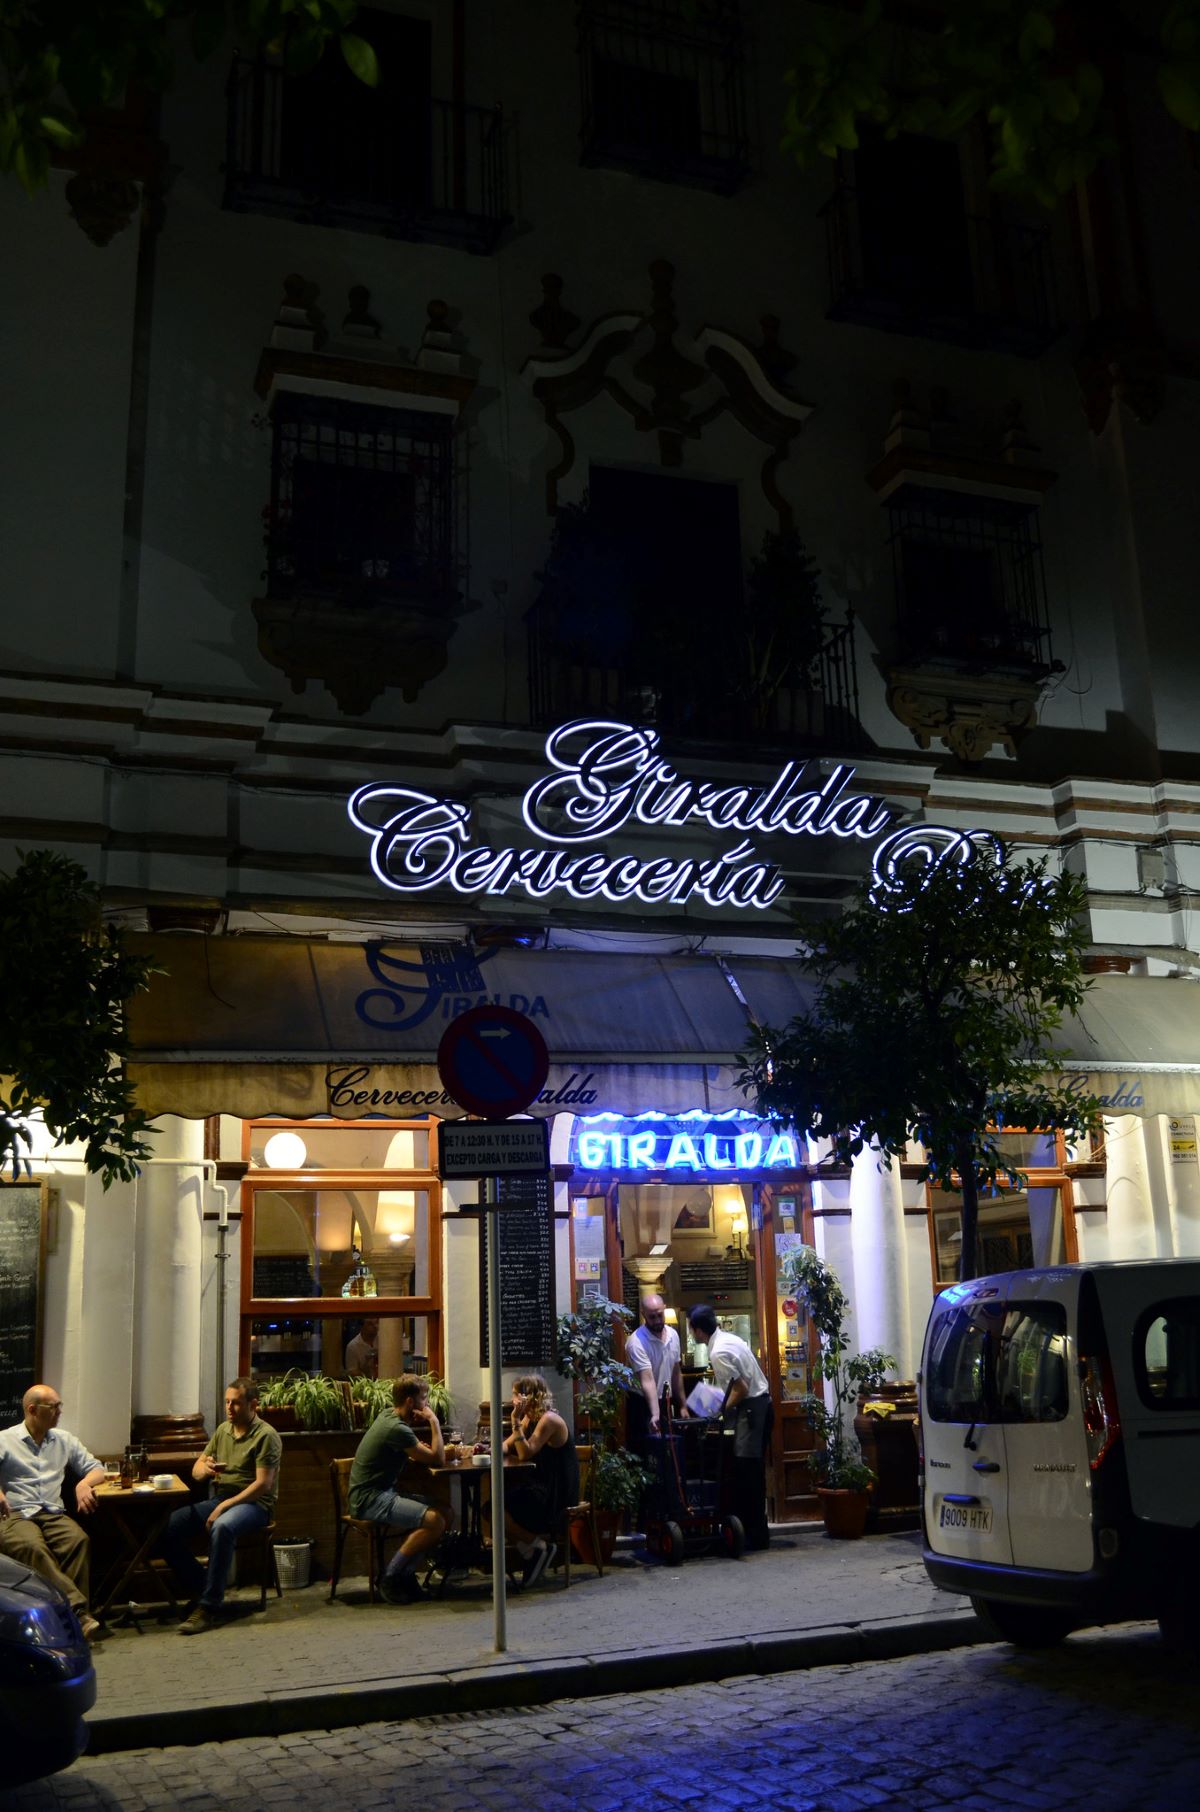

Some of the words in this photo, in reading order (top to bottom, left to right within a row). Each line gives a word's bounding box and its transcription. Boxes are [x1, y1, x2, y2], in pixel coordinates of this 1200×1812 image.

[521, 716, 892, 843] Giralda
[346, 780, 788, 910] Cervecería
[446, 1135, 454, 1147] DE
[461, 1135, 466, 1147] A
[467, 1135, 486, 1147] 12:30
[495, 1134, 500, 1146] Y
[502, 1134, 511, 1146] DE
[512, 1134, 520, 1145] 15
[521, 1134, 526, 1145] A
[528, 1133, 535, 1145] 17
[578, 1130, 797, 1172] GIRALDA
[446, 1152, 476, 1166] EXCEPTO
[477, 1151, 502, 1165] CARGA
[502, 1151, 507, 1163] Y
[508, 1151, 543, 1164] DESCARGA
[945, 1508, 968, 1527] 9009
[970, 1509, 990, 1530] HTK
